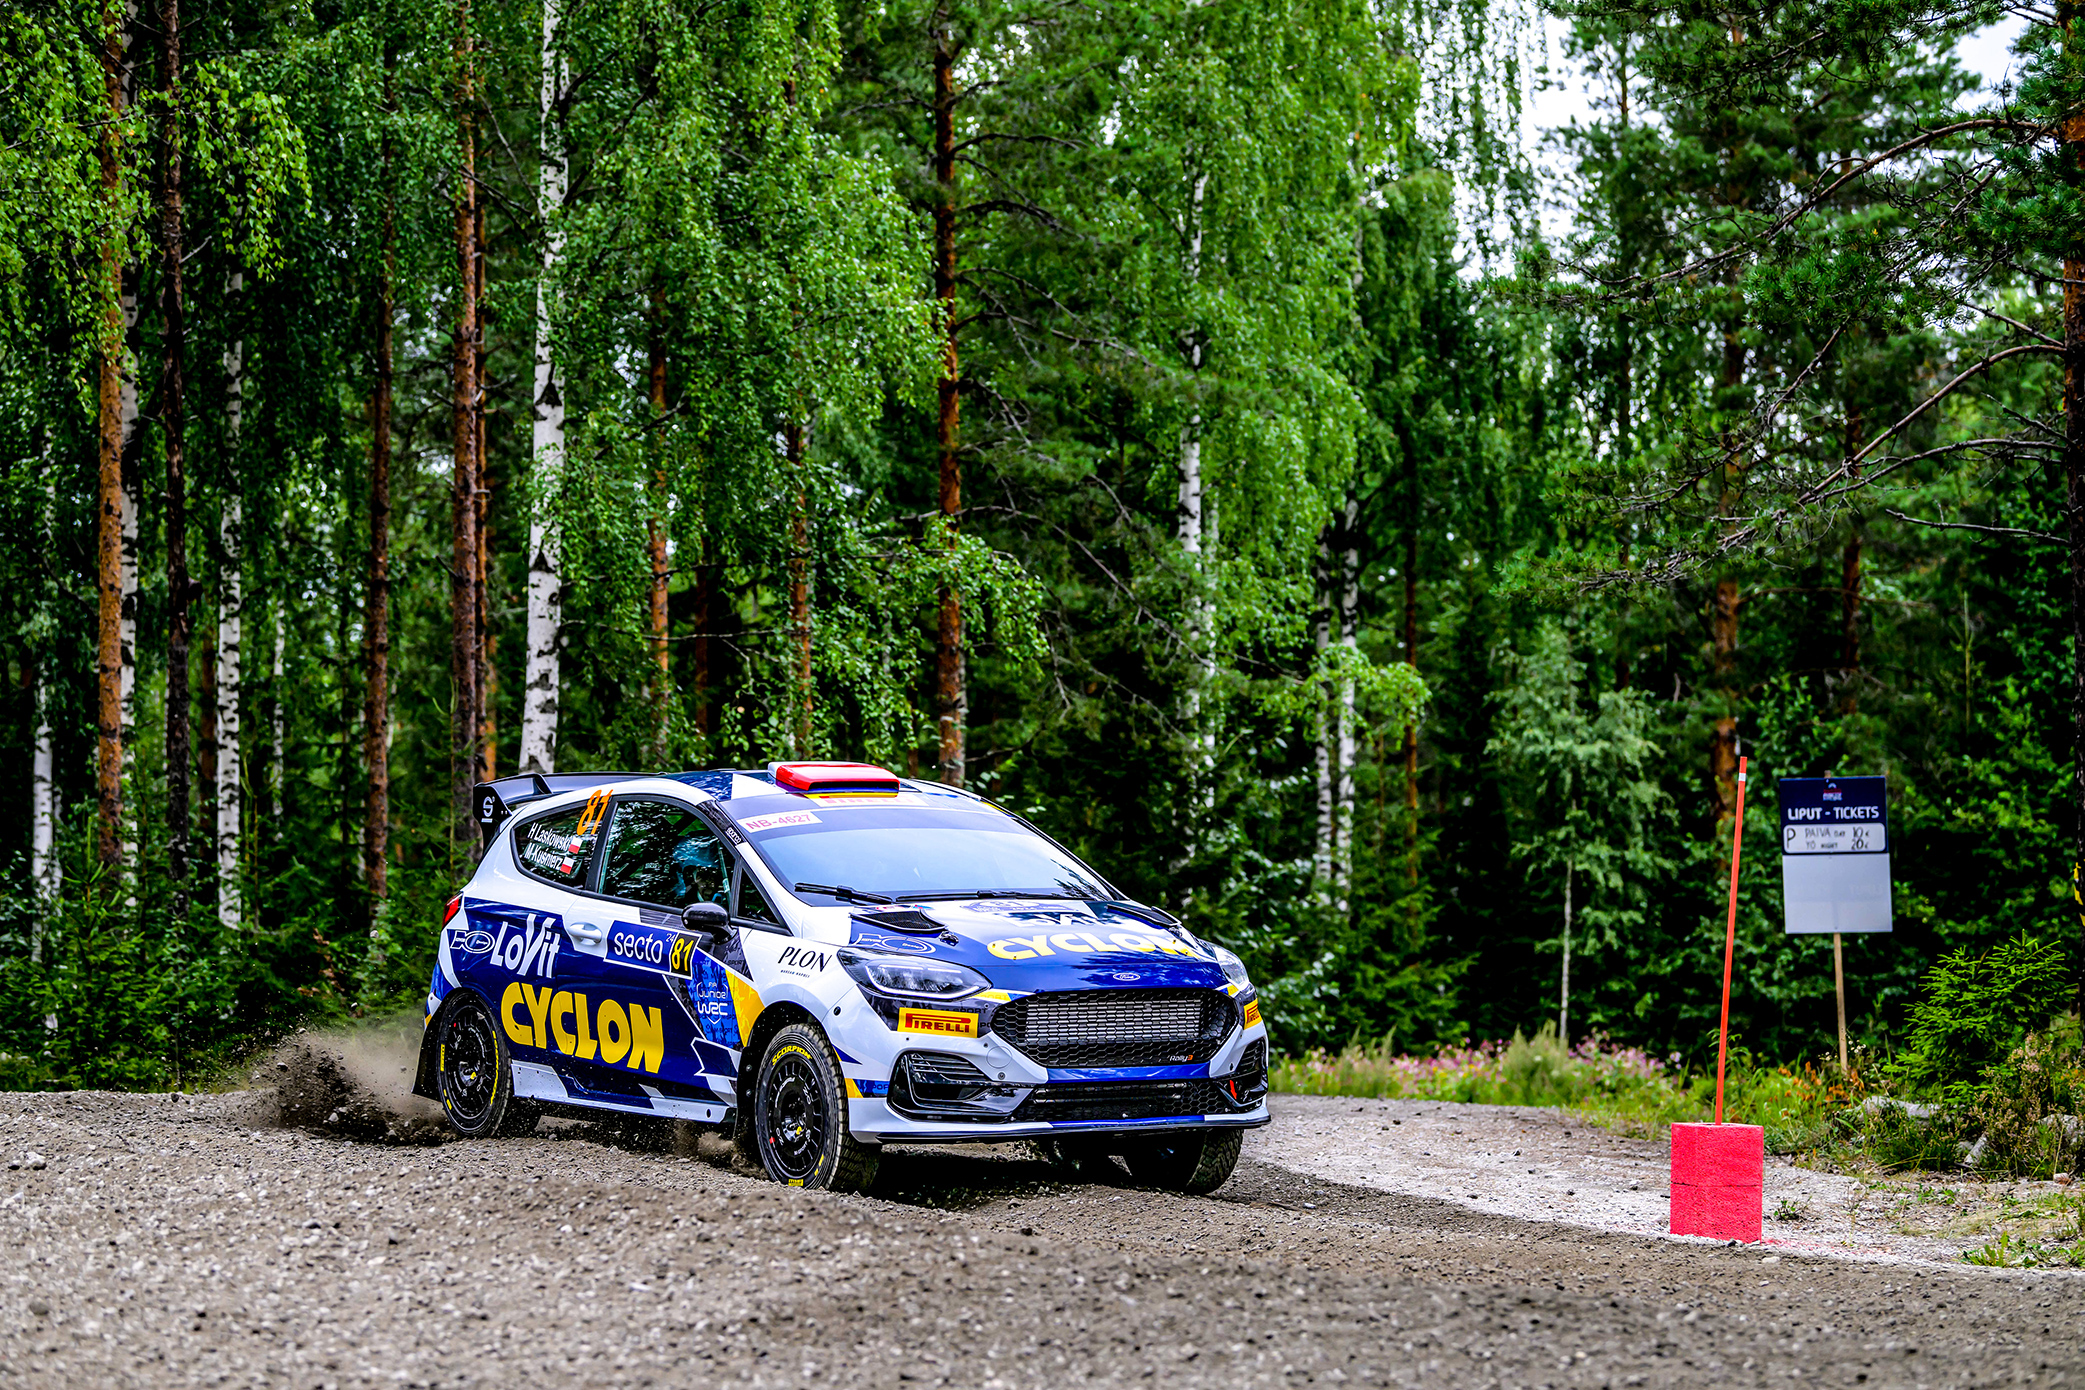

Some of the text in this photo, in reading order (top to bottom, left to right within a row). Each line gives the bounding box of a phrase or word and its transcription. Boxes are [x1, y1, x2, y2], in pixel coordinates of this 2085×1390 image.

[577, 790, 613, 835] 81
[746, 814, 811, 831] NB-4627
[1788, 808, 1822, 820] LIPUT
[1833, 807, 1879, 819] TICKETS
[533, 824, 573, 852] Laskowski
[1787, 828, 1795, 848] P
[1850, 838, 1864, 850] 20
[614, 932, 676, 963] secto 24
[672, 938, 694, 971] 81
[777, 946, 833, 972] PLON
[696, 1000, 729, 1017] WRC
[501, 982, 664, 1073] CYCLON
[904, 1012, 972, 1034] PIRELLI
[771, 1044, 813, 1067] SCORPION
